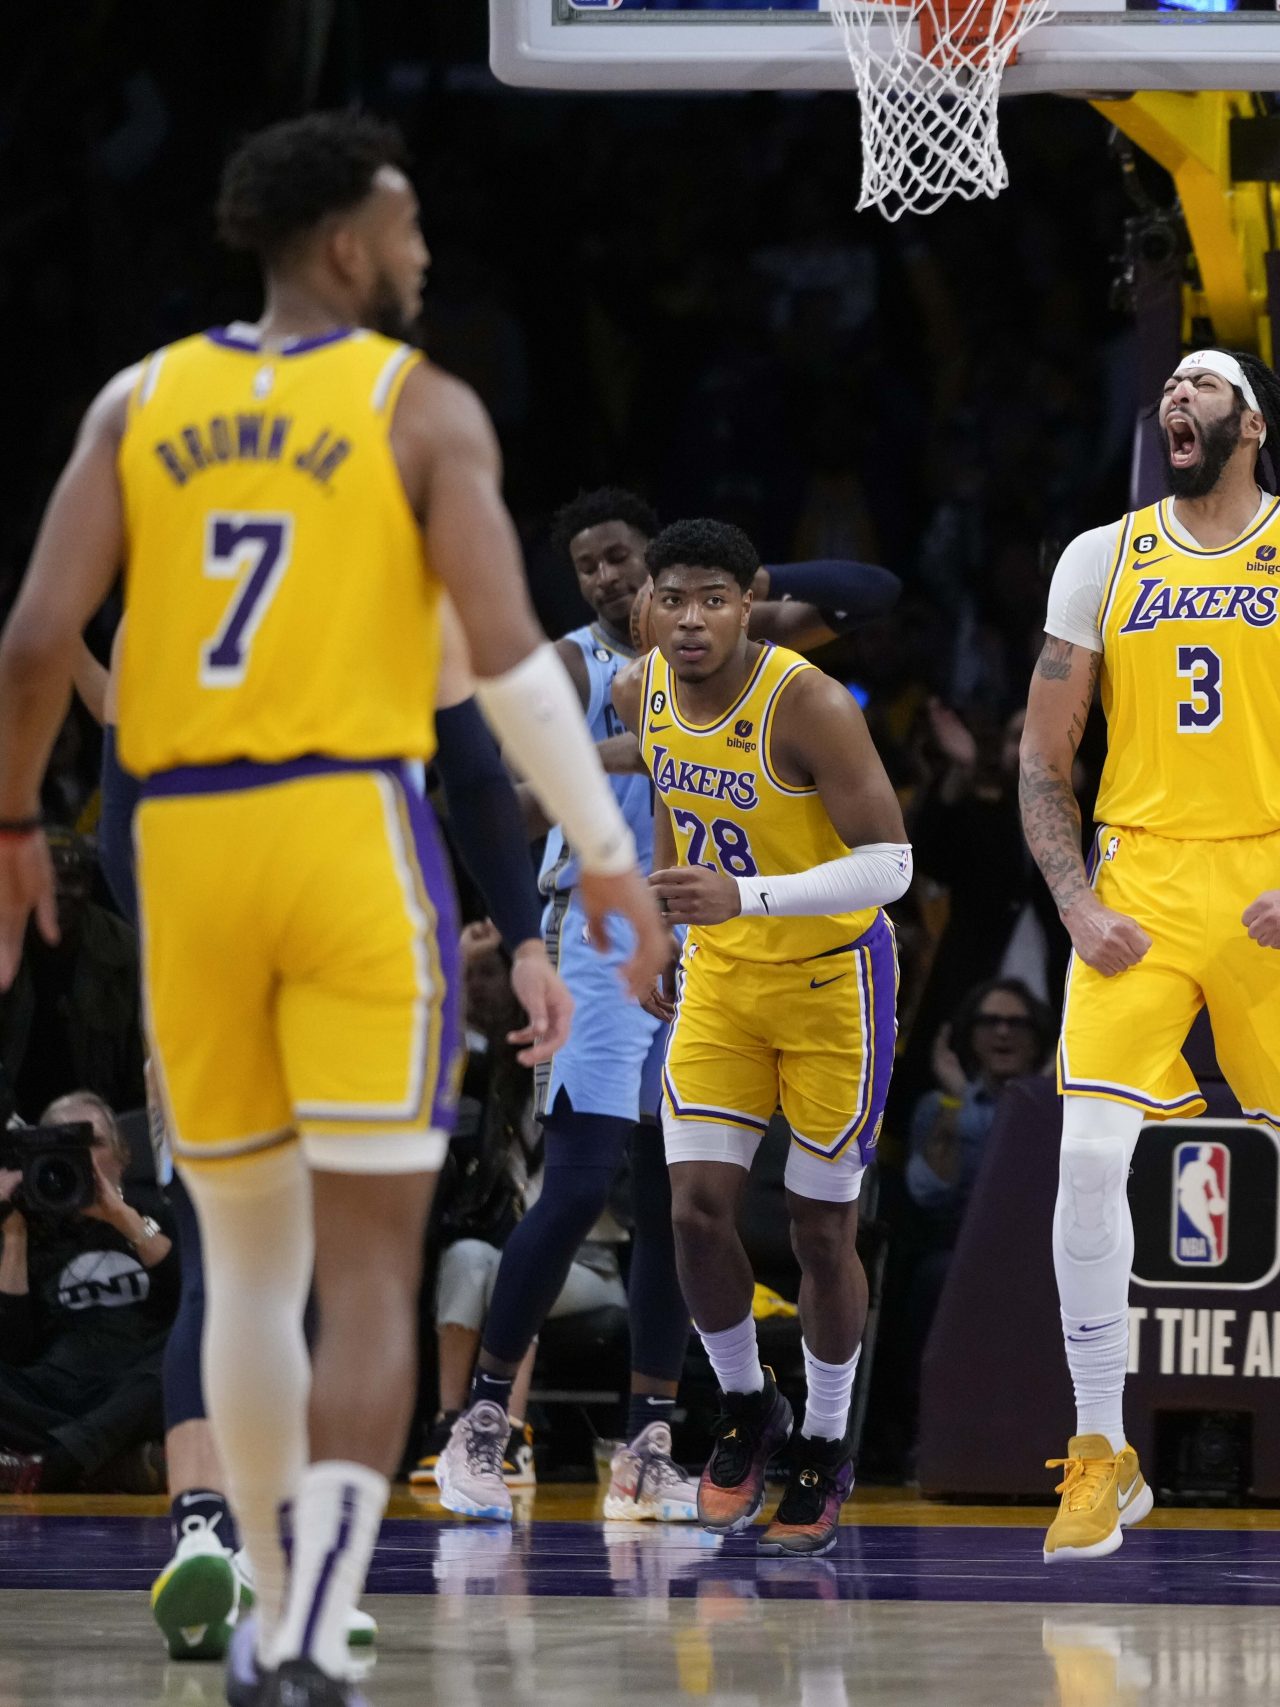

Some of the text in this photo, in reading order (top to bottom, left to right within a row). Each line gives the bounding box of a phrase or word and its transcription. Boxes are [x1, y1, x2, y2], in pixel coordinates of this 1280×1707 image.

[154, 413, 293, 489] BROWN
[1138, 536, 1153, 553] 6
[199, 513, 295, 689] 7
[1118, 578, 1280, 634] LAKERS
[653, 693, 664, 713] 6
[1176, 645, 1223, 734] 3
[651, 744, 759, 811] LAKERS
[726, 737, 757, 753] bibigo
[671, 806, 760, 877] 28
[1155, 1308, 1236, 1376] THE
